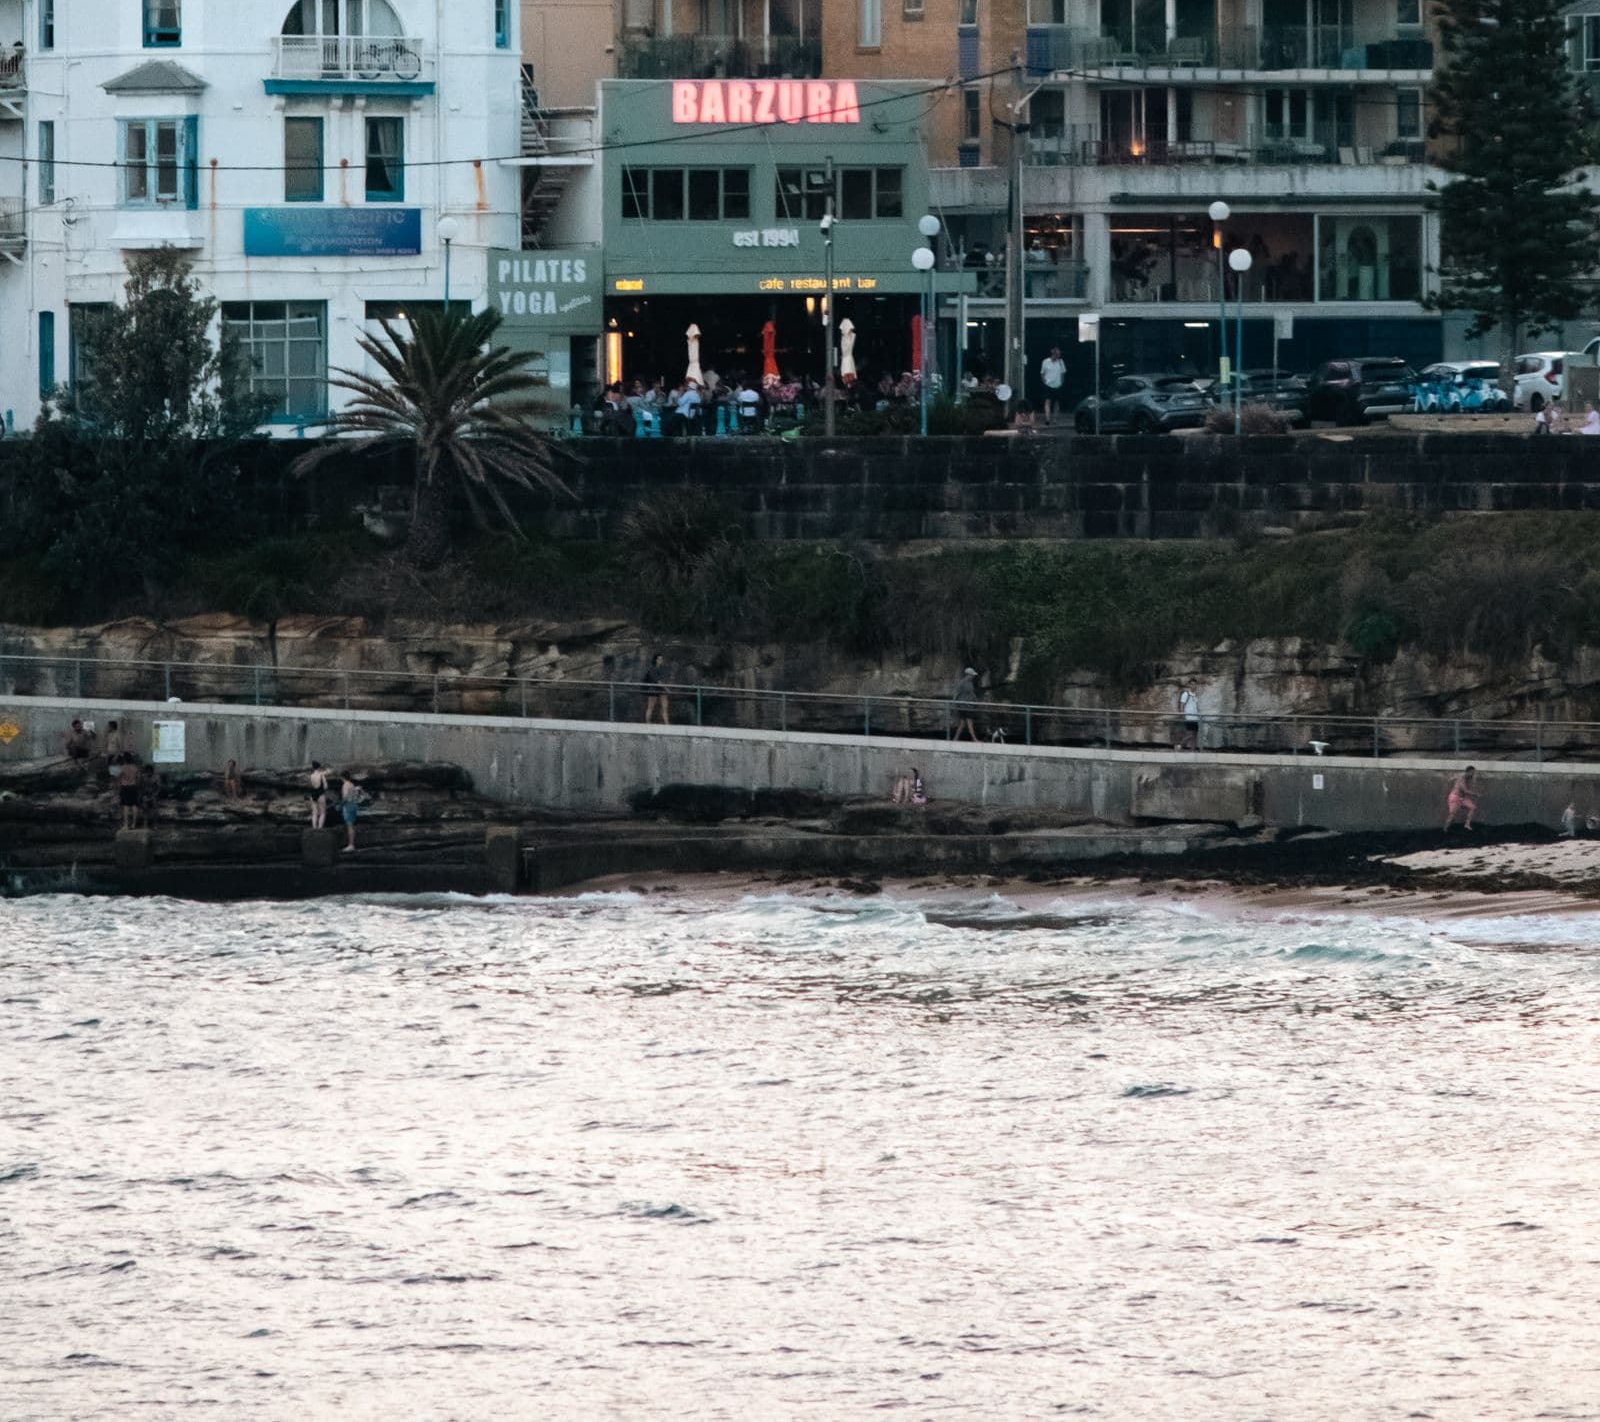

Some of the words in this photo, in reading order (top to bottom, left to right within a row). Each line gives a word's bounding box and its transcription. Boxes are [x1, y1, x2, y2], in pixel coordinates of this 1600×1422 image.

[673, 81, 860, 123] BARZURA
[733, 230, 759, 247] est
[760, 229, 799, 247] 1994
[498, 259, 586, 283] PILATES
[759, 278, 784, 290] cafe
[790, 277, 851, 289] restauant
[857, 277, 877, 288] bar
[499, 291, 557, 314] YOGA
